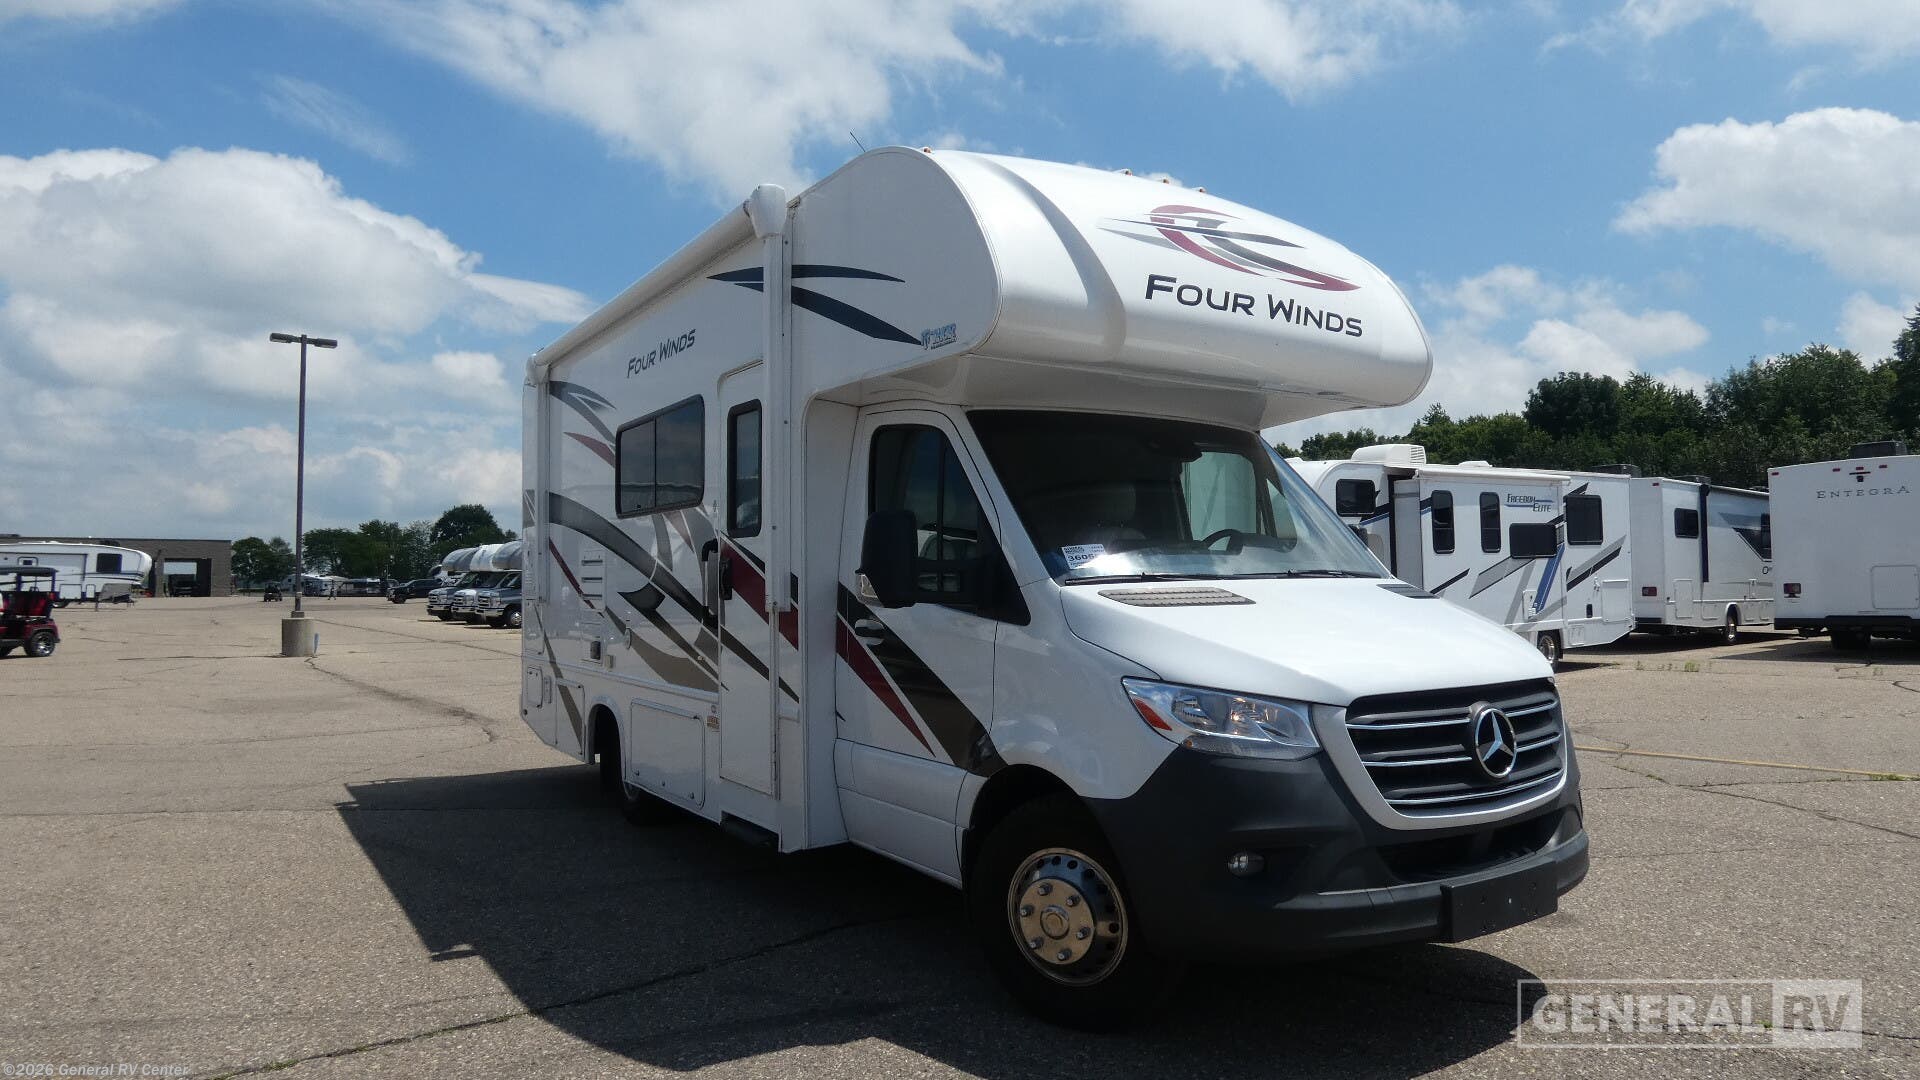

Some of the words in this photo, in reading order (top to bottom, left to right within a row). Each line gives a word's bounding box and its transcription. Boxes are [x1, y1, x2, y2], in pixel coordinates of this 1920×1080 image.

[1145, 274, 1255, 316] FOUR
[1267, 294, 1362, 337] WINDS
[627, 350, 656, 378] FOUR
[659, 329, 696, 362] WINDS
[1507, 493, 1536, 503] FREEDOM
[1816, 485, 1911, 499] ENTEGRA
[1533, 503, 1551, 512] ELITE
